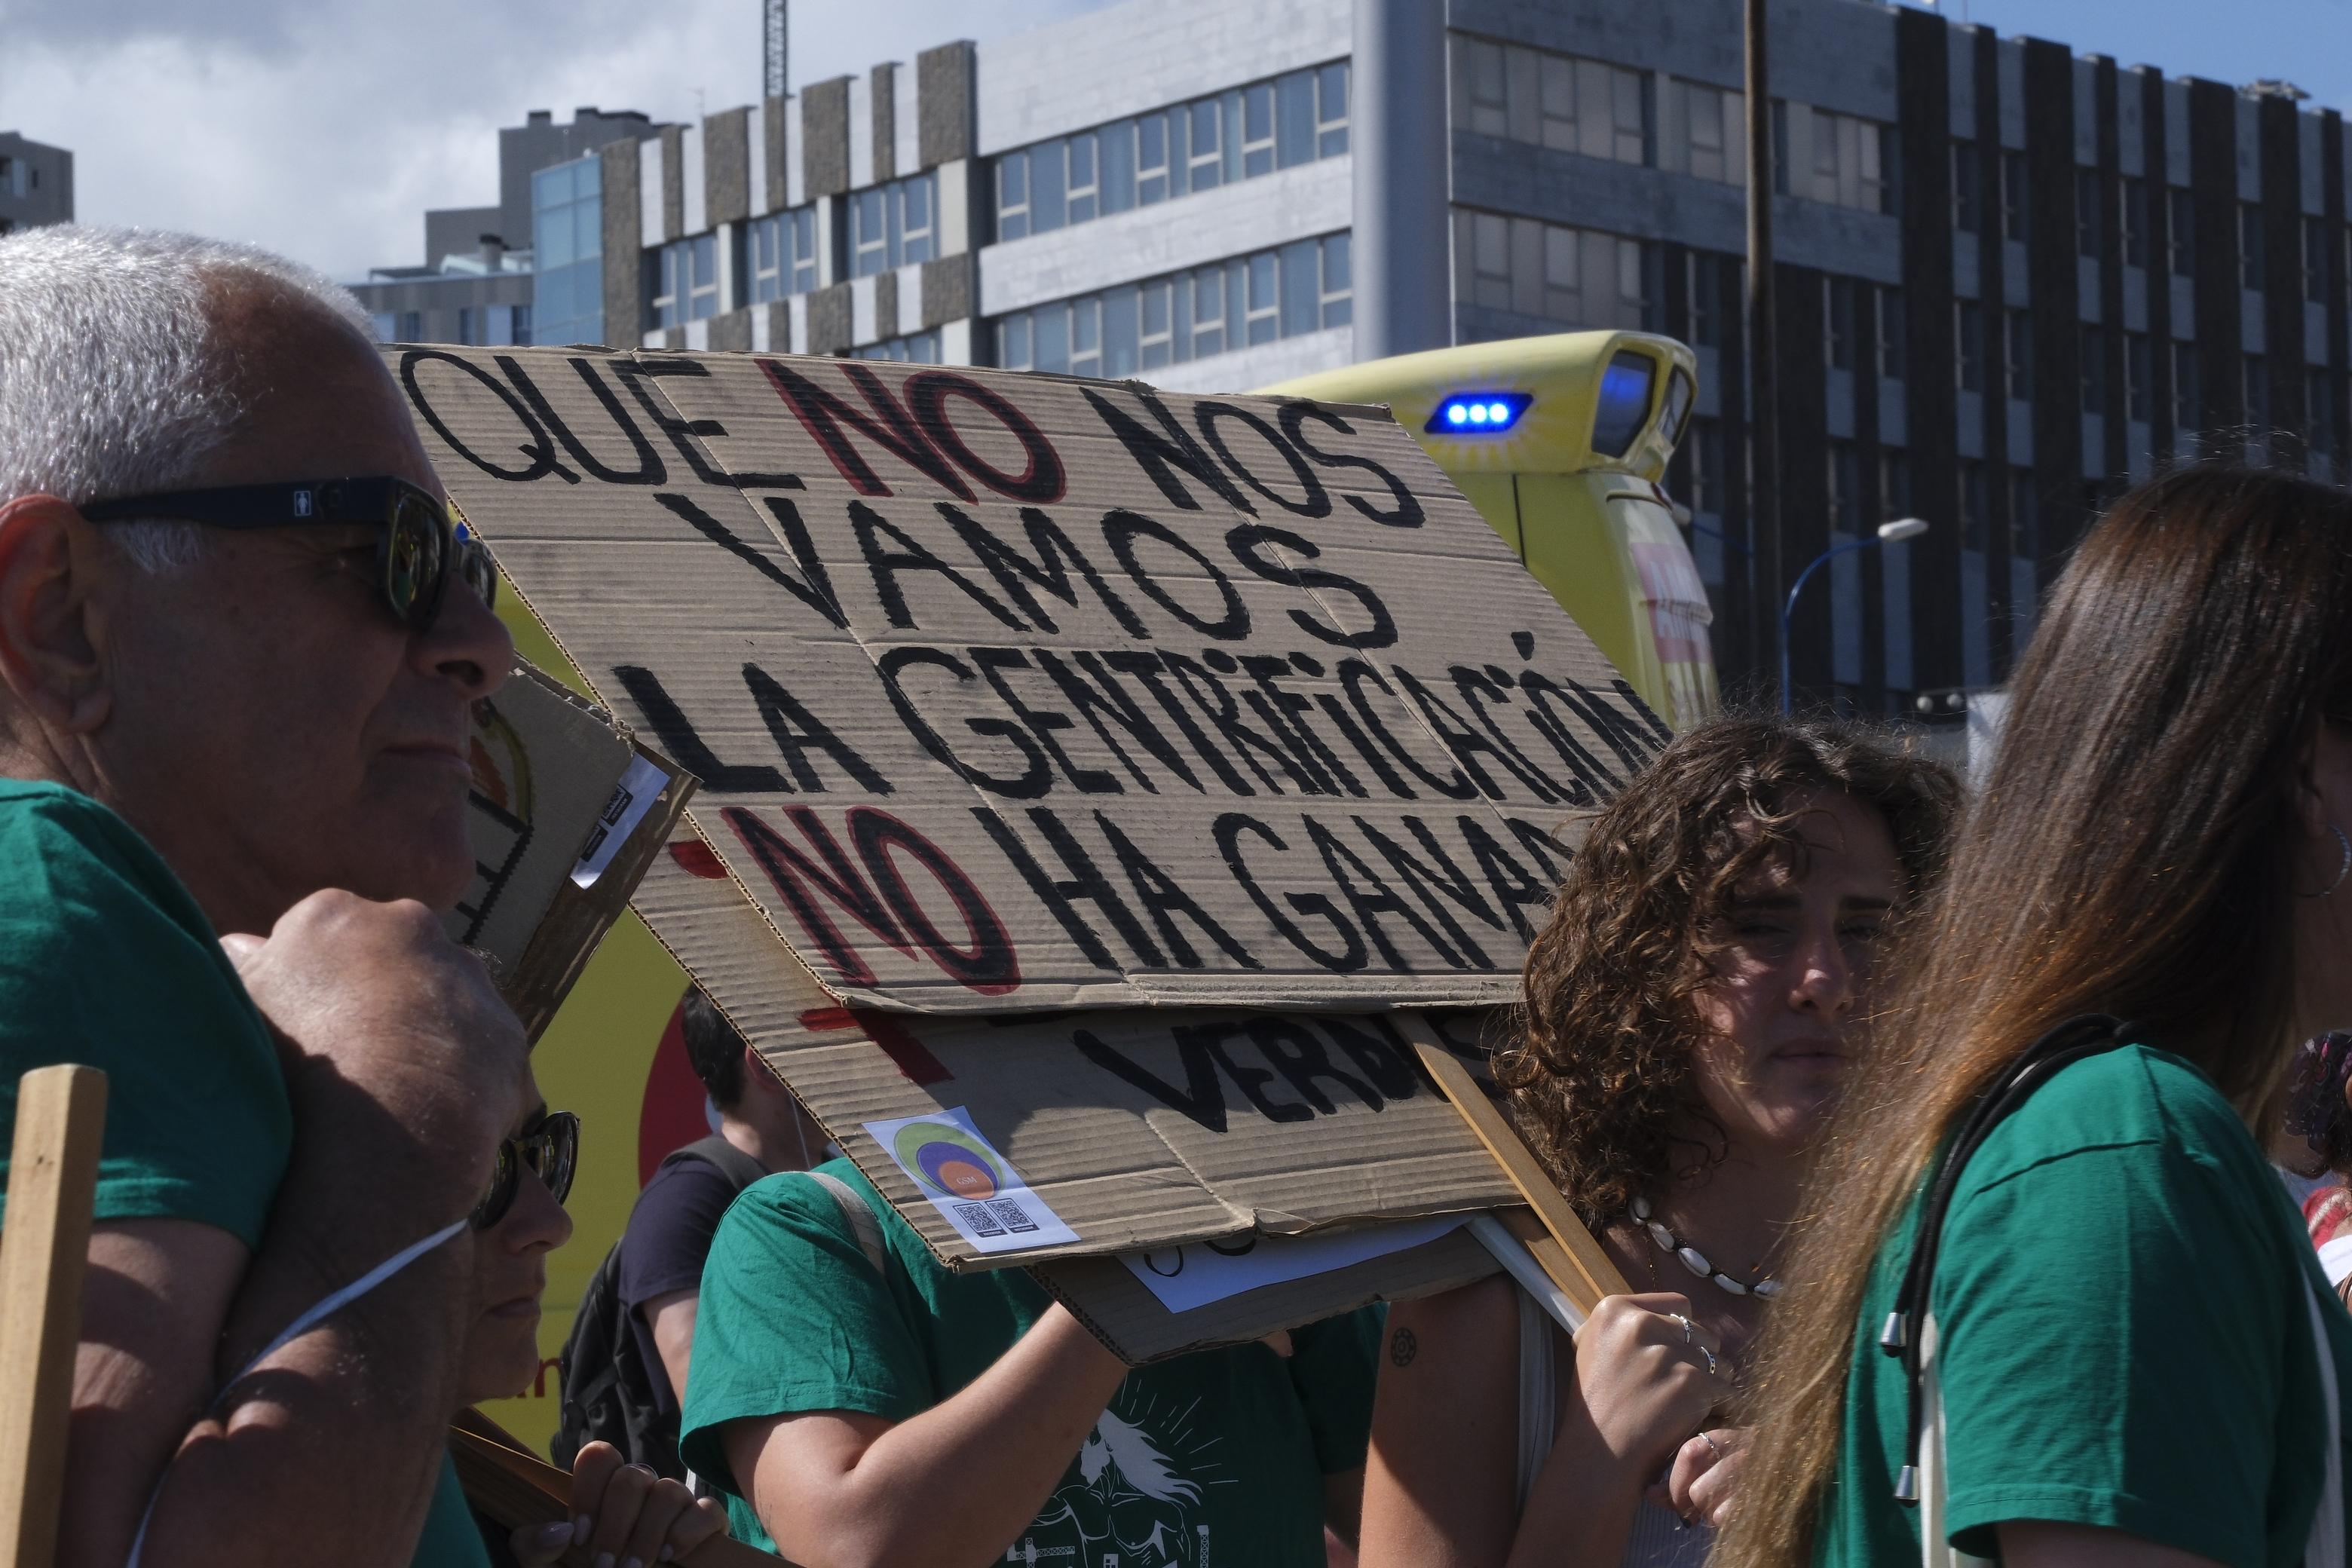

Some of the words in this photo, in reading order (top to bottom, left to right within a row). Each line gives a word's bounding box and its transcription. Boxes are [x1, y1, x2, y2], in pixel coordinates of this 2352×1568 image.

[400, 350, 807, 492] QUE
[755, 358, 1068, 506] NO
[1078, 384, 1426, 528] NOS
[653, 493, 1398, 649] VAMOS
[610, 661, 896, 797] LA
[720, 805, 1021, 997] NO
[968, 806, 1262, 973] HA
[956, 1177, 978, 1186] GSM
